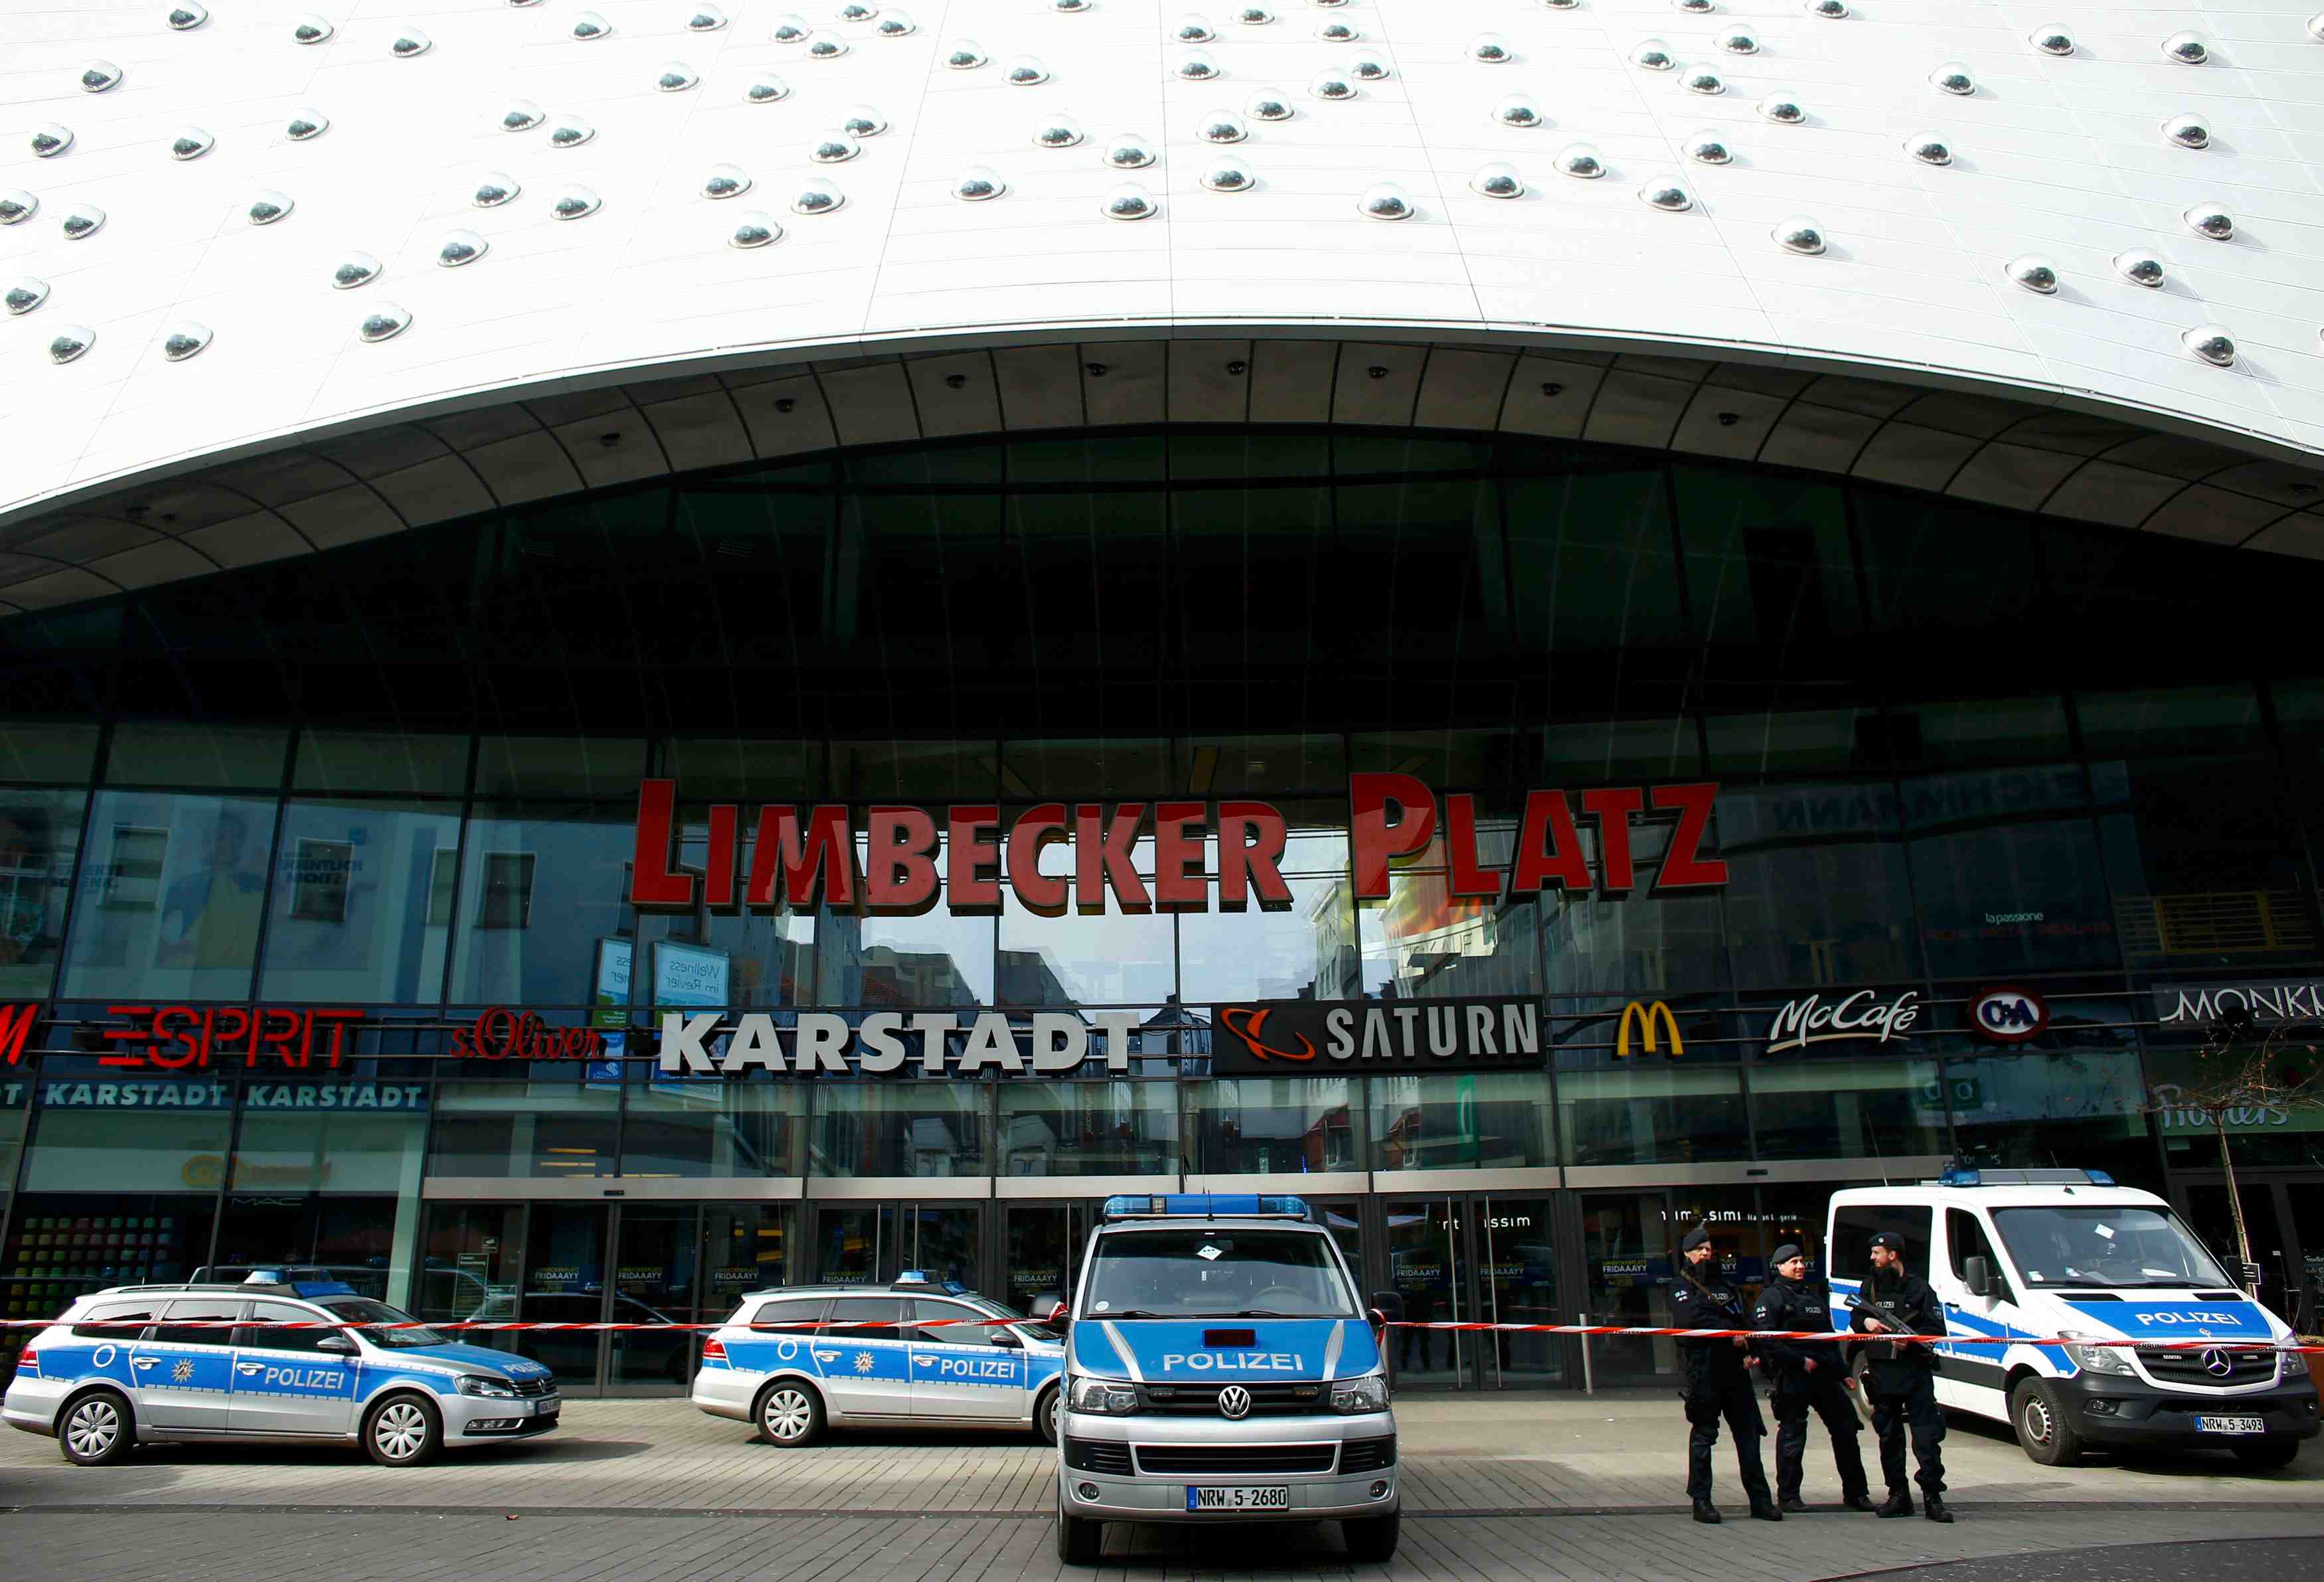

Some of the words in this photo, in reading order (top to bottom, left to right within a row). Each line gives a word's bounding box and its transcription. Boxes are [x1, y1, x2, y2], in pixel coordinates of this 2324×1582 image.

[630, 778, 1293, 913] LIMBECKER
[1349, 771, 1728, 902] PLATZ
[1769, 989, 1919, 1048] McCafé
[98, 1006, 366, 1069] ESPRIT
[449, 1006, 600, 1060] s.Oliver
[659, 1012, 1141, 1073] KARSTADT
[1325, 1003, 1538, 1060] SATURN
[44, 1083, 228, 1107] KARSTADT
[247, 1085, 422, 1108] KARSTADT
[535, 1271, 579, 1280] FRIDAAAYY
[618, 1271, 662, 1280] FRIDAAAYY
[714, 1271, 759, 1280] FRIDAAAYY
[2134, 1311, 2242, 1326] POLIZEI
[940, 1359, 1015, 1380] POLIZEI
[1163, 1352, 1303, 1372] POLIZEI
[264, 1366, 345, 1390] POLIZEI
[2202, 1417, 2222, 1430] NRW
[1198, 1489, 1225, 1506] NRW
[1234, 1489, 1287, 1506] 5-2680
